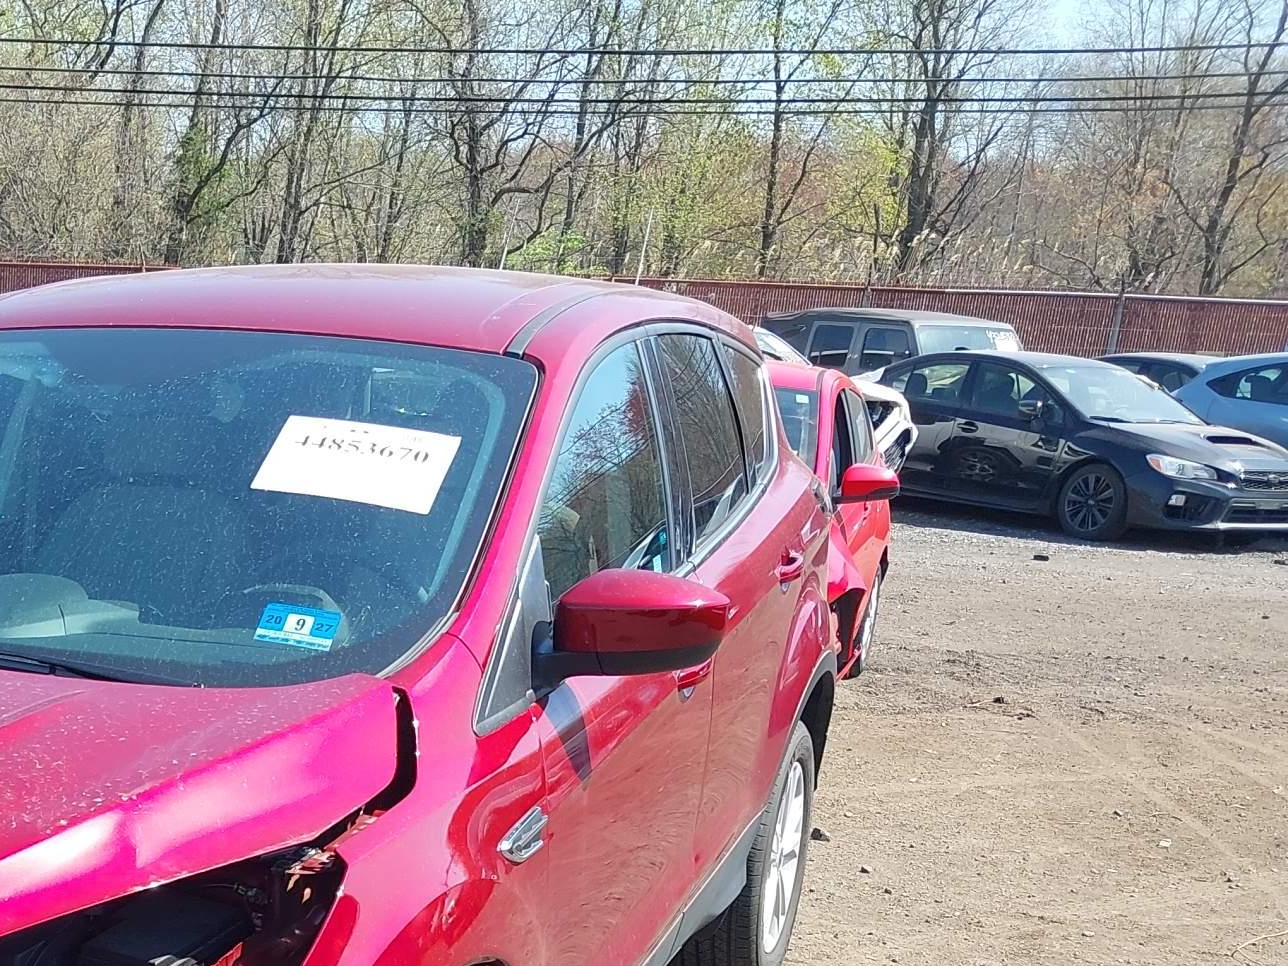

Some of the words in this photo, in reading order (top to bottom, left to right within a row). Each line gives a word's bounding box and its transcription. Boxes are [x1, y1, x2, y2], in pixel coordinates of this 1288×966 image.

[265, 614, 283, 625] 20
[294, 618, 306, 632] 9
[314, 622, 334, 633] 27
